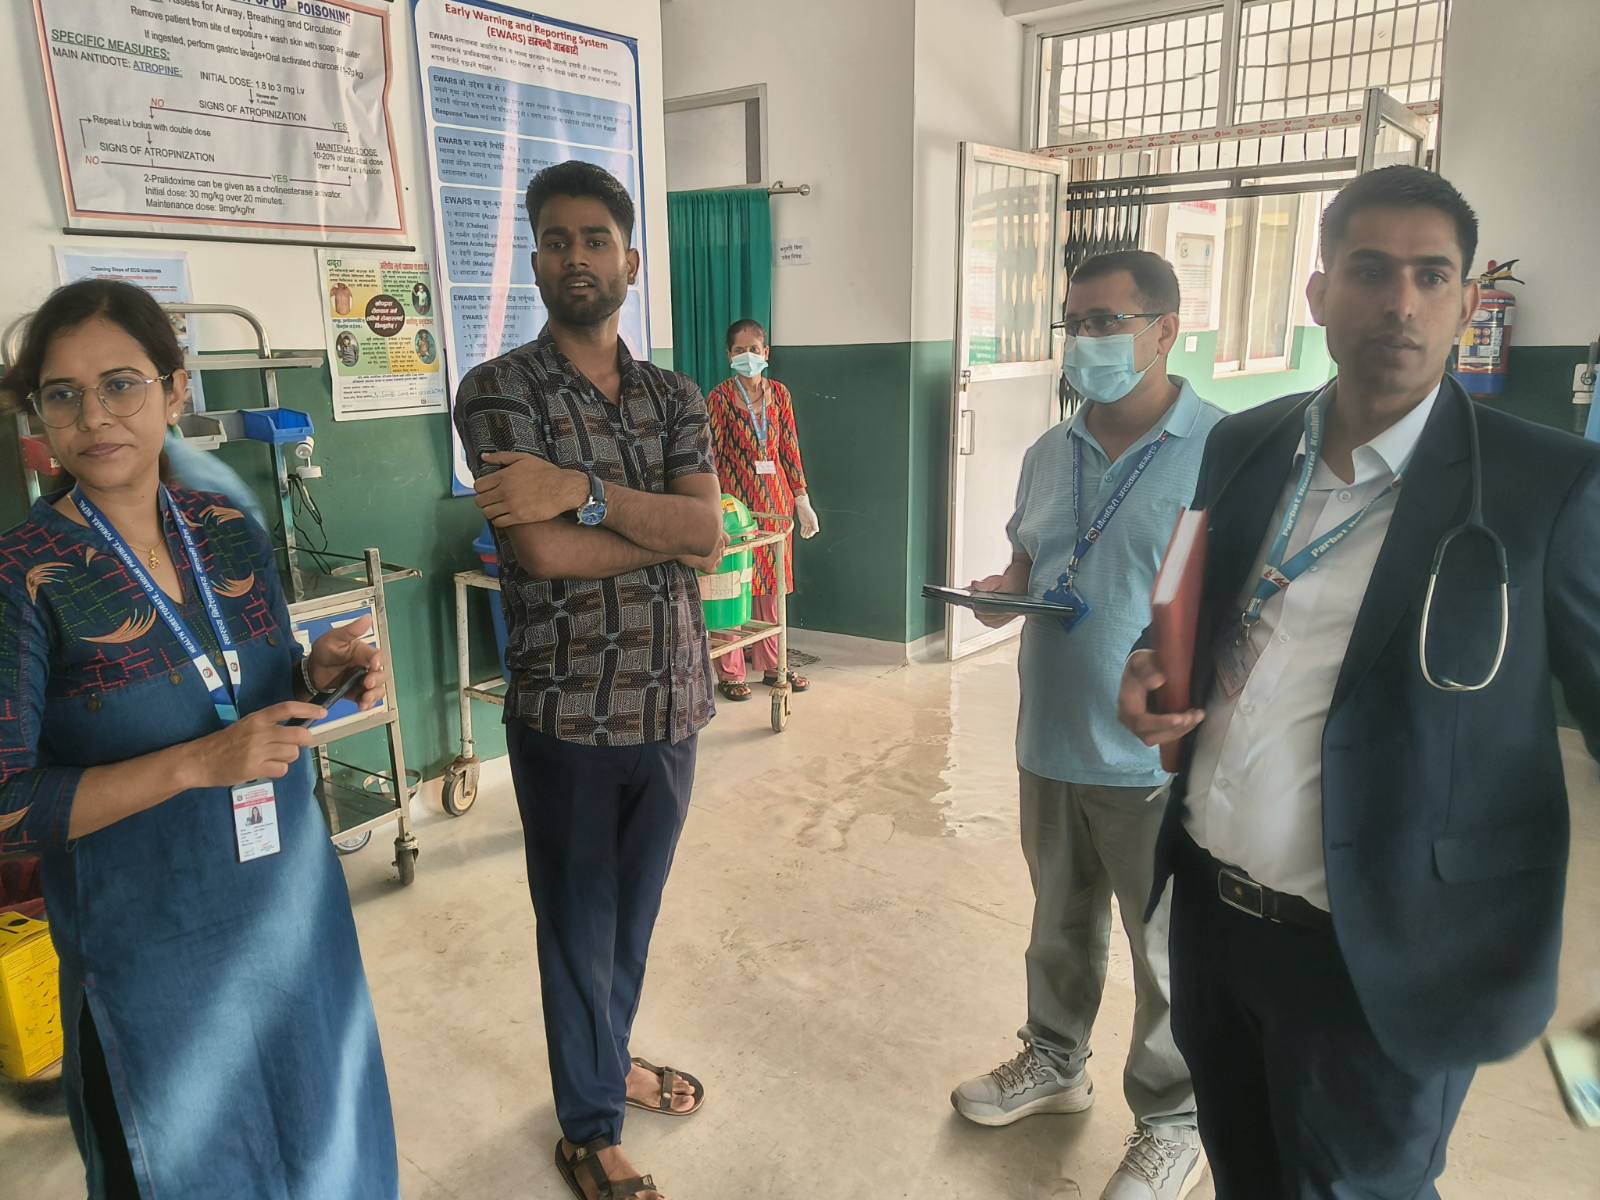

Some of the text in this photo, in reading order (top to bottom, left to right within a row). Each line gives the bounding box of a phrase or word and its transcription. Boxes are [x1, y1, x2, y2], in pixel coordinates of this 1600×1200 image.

[202, 1, 214, 12] for
[216, 3, 245, 20] Airway,
[247, 10, 284, 28] Breathing
[287, 16, 301, 29] and
[304, 21, 342, 36] Circulation
[298, 2, 351, 24] POISONING
[131, 5, 163, 21] Remove
[165, 12, 191, 27] patient
[192, 17, 208, 29] from
[210, 22, 222, 32] site
[224, 25, 231, 33] of
[232, 28, 263, 42] exposure
[270, 35, 288, 45] wash
[290, 38, 303, 48] skin
[304, 40, 317, 50] with
[429, 31, 453, 42] EWARS
[445, 3, 470, 19] Early
[472, 9, 514, 30] Warning
[515, 21, 532, 32] and
[534, 25, 577, 45] Reporting
[579, 36, 609, 50] System
[487, 25, 526, 46] (EWARS)
[51, 29, 170, 60] SPECIFIC MEASURES:
[145, 29, 150, 39] If
[152, 30, 186, 46] ingested,
[187, 38, 215, 51] perform
[216, 44, 239, 56] gastric
[282, 54, 311, 67] activated
[52, 47, 183, 78] MAIN ANTIDOTE: ATROPINE:
[200, 71, 227, 84] INITIAL
[255, 81, 266, 90] 1.8
[268, 82, 275, 92] to
[277, 84, 282, 92] 3
[283, 86, 295, 96] mg
[433, 74, 457, 85] EWARS
[151, 98, 164, 108] NO
[199, 100, 306, 122] SIGNS OF ATROPINIZATION
[92, 114, 121, 127] Repeat
[133, 120, 152, 130] bolus
[153, 123, 168, 132] with
[169, 124, 192, 135] double
[194, 127, 211, 137] dose
[331, 122, 347, 131] YES
[438, 136, 462, 146] EWARS
[85, 155, 99, 165] NO
[100, 142, 215, 162] SIGNS OF ATROPINIZATION
[313, 151, 335, 160] 10-20%
[368, 158, 384, 166] dose
[337, 164, 349, 172] hour
[144, 173, 195, 187] 2-Pralidoxime
[197, 179, 210, 188] can
[212, 179, 222, 189] be
[224, 182, 244, 192] given
[245, 183, 254, 191] as
[263, 185, 313, 197] cholinesterase
[271, 174, 288, 183] YES
[145, 186, 165, 196] Initial
[167, 188, 187, 198] dose:
[189, 189, 199, 198] 30
[201, 191, 224, 201] mg/kg
[226, 194, 242, 202] over
[243, 193, 253, 202] 20
[444, 196, 472, 206] EWARS
[146, 198, 255, 216] Maintenance dose: 9mg/kg/hr
[453, 294, 477, 302] EWARS
[78, 499, 94, 518] NEPAL
[1282, 497, 1301, 537] Parbat
[135, 569, 155, 593] GANDAKI
[178, 629, 197, 654] HEALTH
